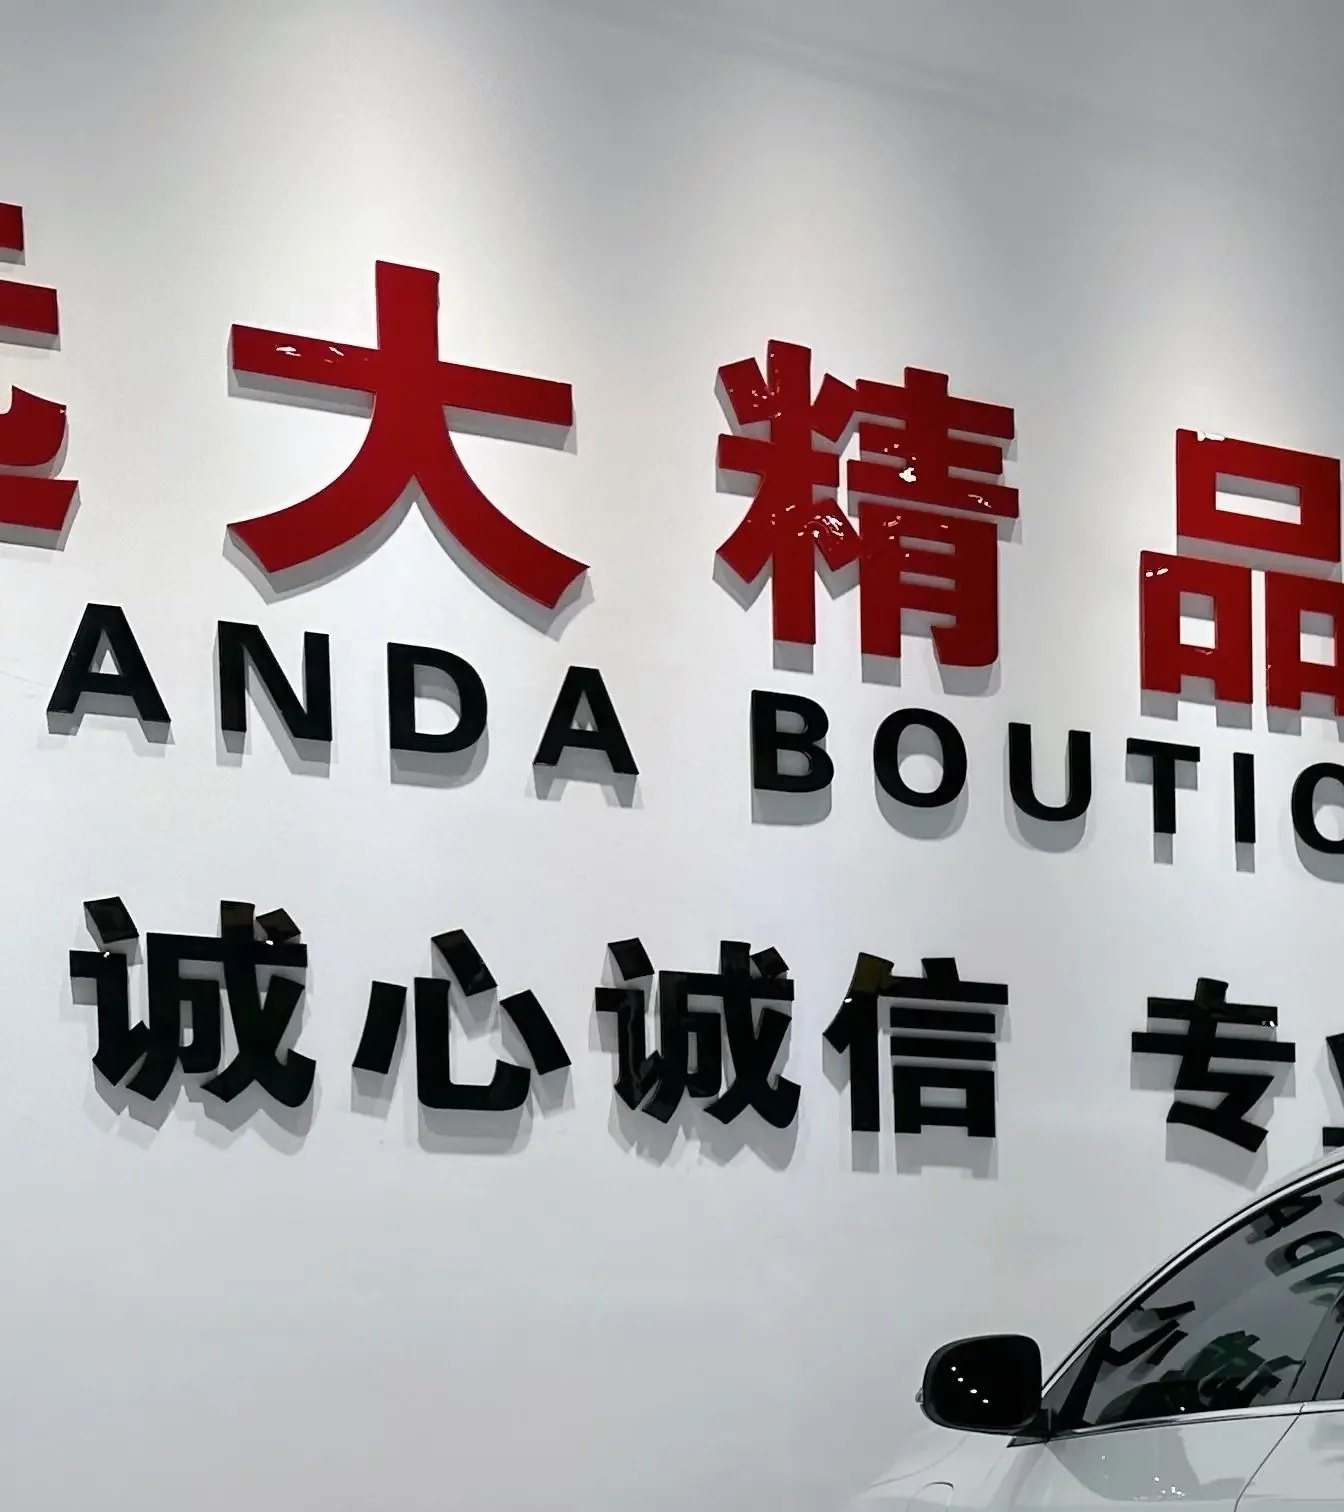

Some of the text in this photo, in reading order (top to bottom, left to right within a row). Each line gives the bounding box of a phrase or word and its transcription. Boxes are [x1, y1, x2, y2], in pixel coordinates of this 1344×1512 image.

[46, 602, 640, 776] ANDA
[68, 896, 1010, 1139] 诚心诚信
